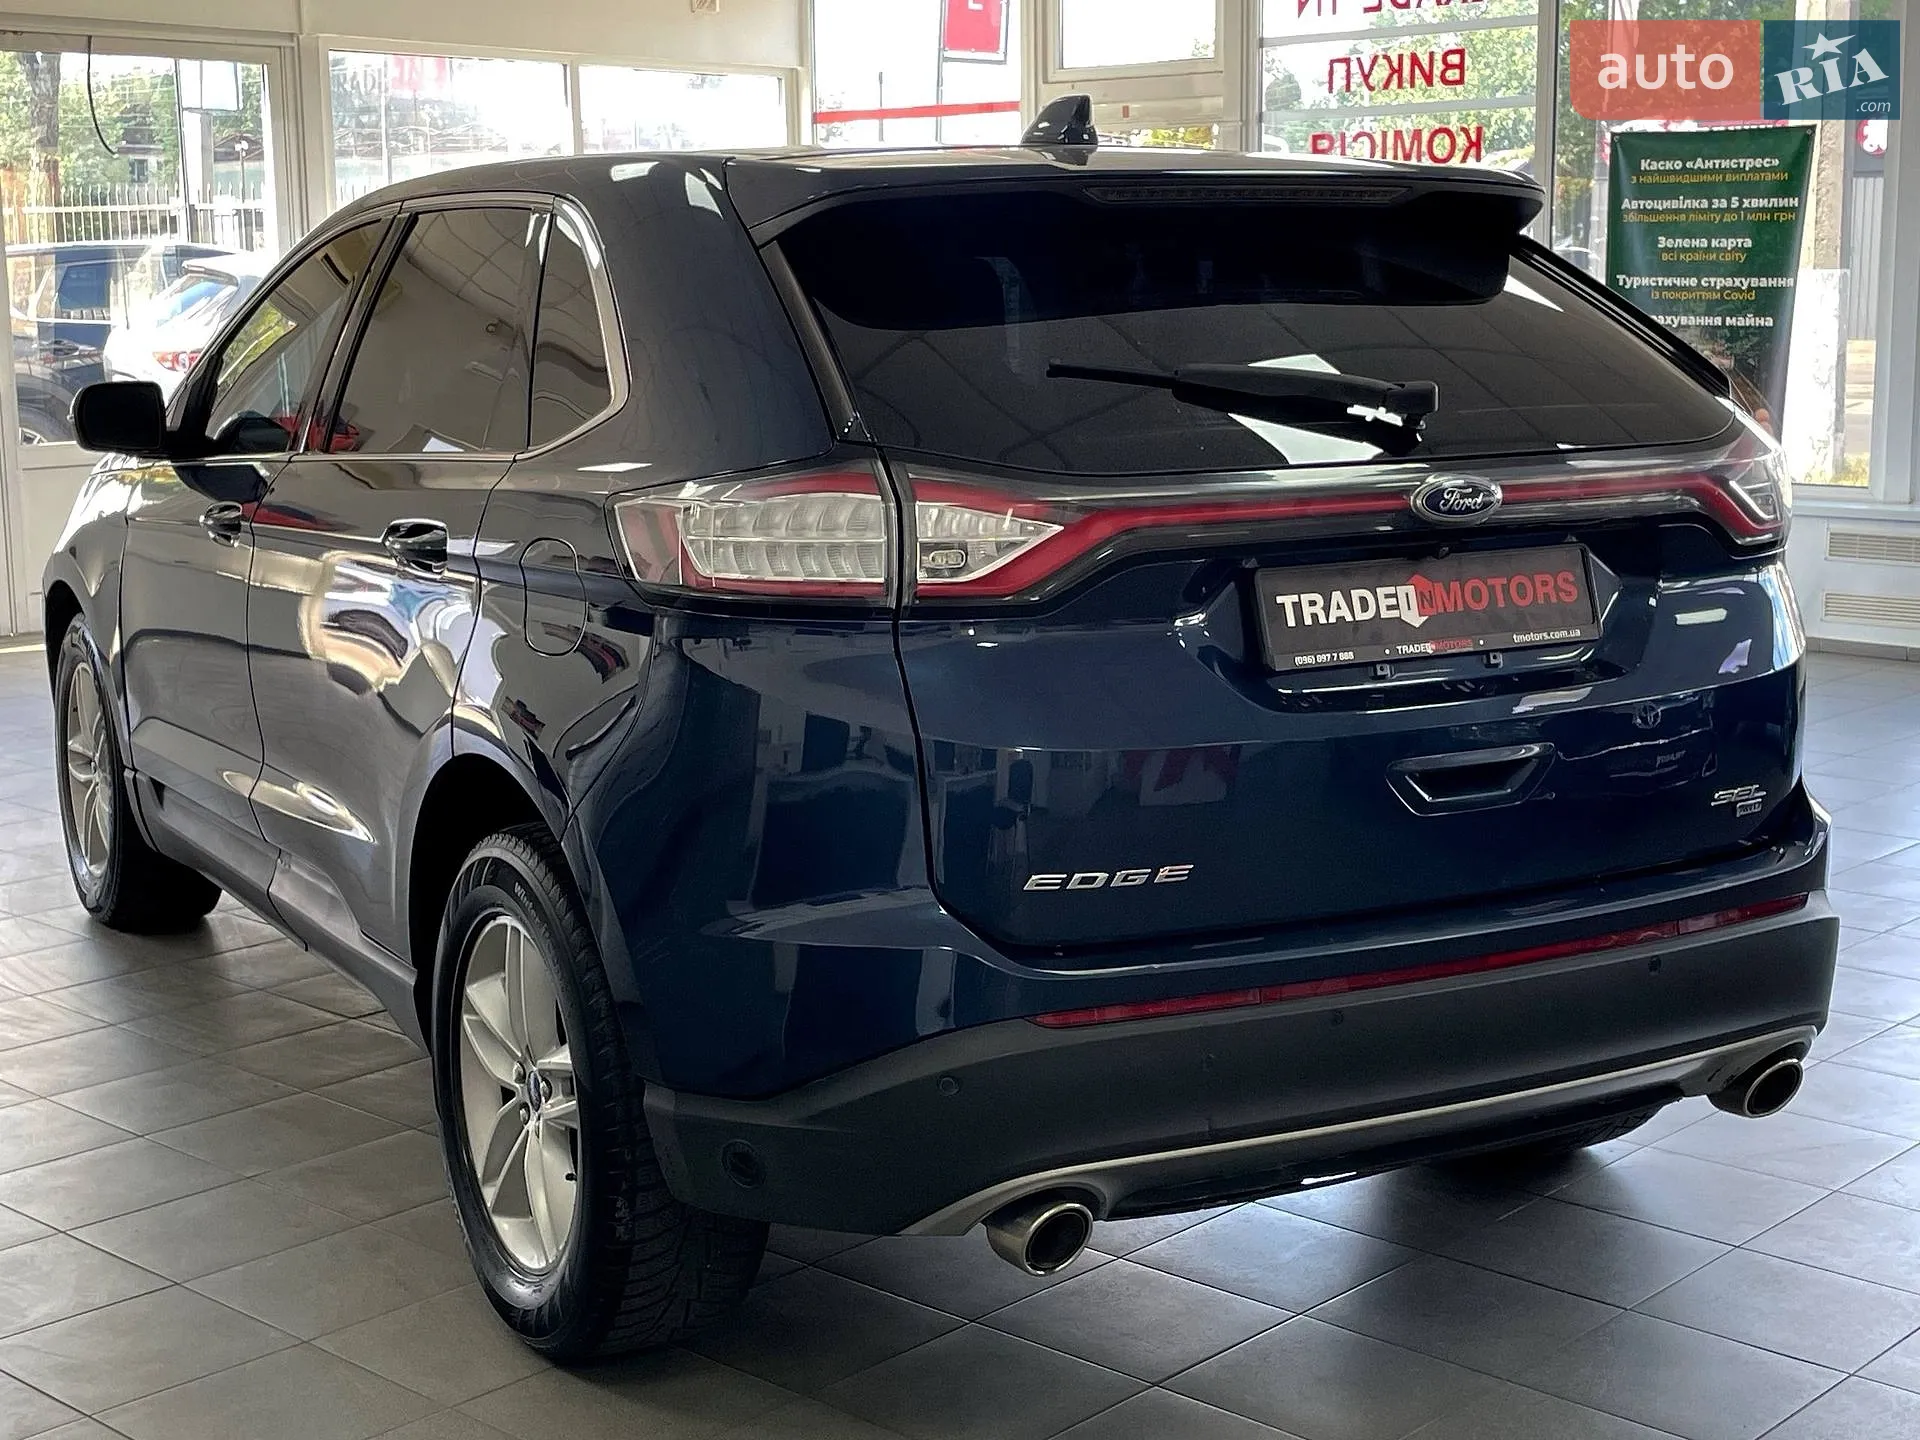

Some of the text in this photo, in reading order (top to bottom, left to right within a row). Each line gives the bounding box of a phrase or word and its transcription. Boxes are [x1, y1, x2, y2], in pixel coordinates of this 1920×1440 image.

[1640, 157, 1780, 171] Каско «Антистрес»
[1639, 172, 1723, 184] найшвидшими
[1725, 171, 1788, 182] виплатами
[1621, 196, 1800, 210] Автоцивілка за 5 хвилин
[1623, 211, 1687, 223] збільшення
[1688, 211, 1721, 224] ліміту
[1723, 212, 1738, 223] до
[1747, 212, 1771, 222] млн
[1773, 212, 1796, 224] грн
[1657, 236, 1753, 250] Зелена карта
[1661, 250, 1747, 263] всі країни світу
[1616, 274, 1795, 290] Туристичне страхування
[1661, 291, 1721, 302] покриттям
[1723, 290, 1756, 301] Covid
[1725, 314, 1774, 328] майна
[1439, 487, 1484, 511] Ford
[1512, 628, 1581, 644] tmotors.com.ua
[1022, 864, 1195, 891] EDGE
